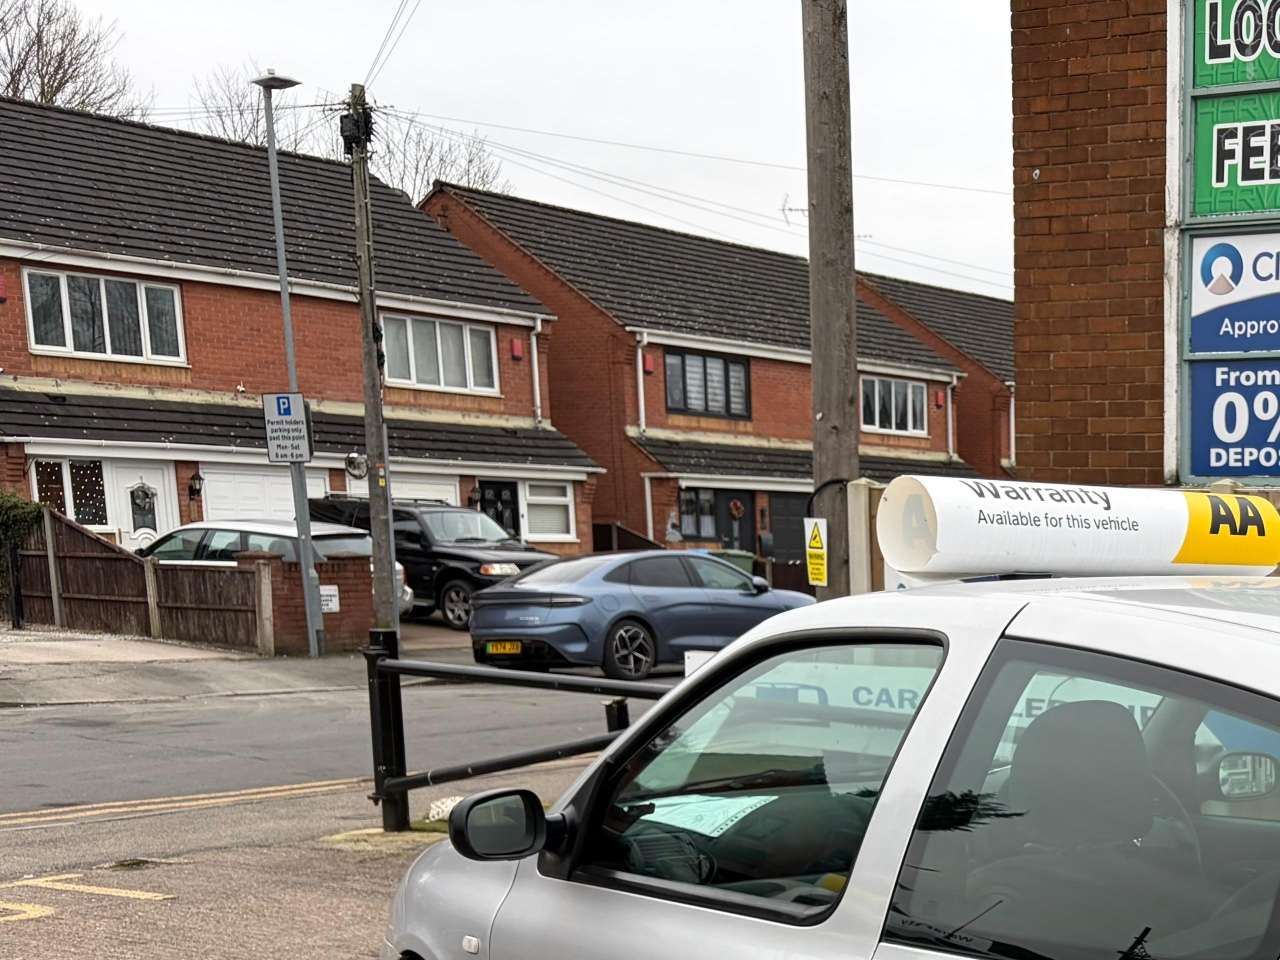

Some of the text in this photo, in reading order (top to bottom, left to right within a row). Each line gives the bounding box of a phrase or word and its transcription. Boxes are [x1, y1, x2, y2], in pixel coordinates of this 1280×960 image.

[1216, 367, 1280, 387] From
[960, 480, 1112, 511] Warranty
[978, 509, 1140, 532] Available for this vehicle
[1208, 494, 1266, 537] AA
[852, 685, 919, 710] CAR
